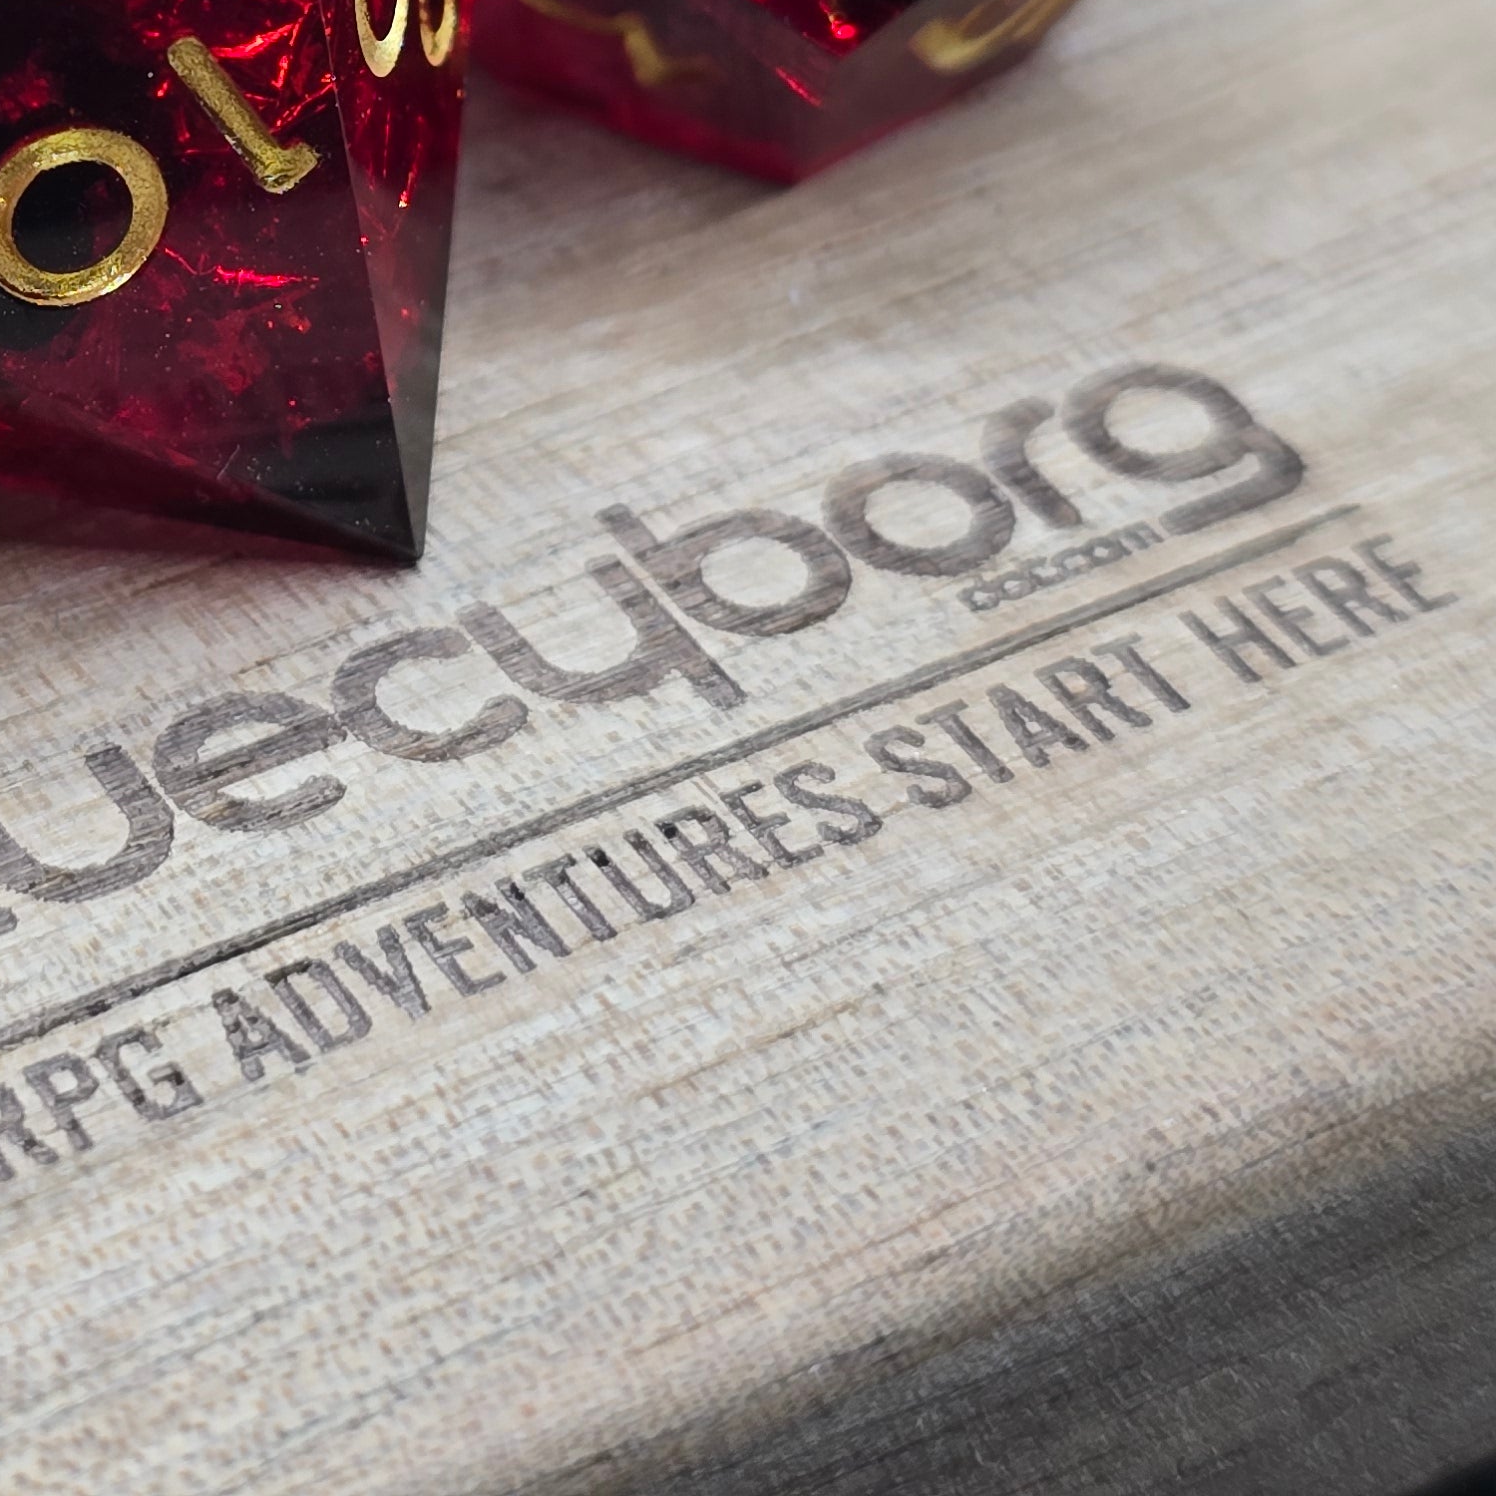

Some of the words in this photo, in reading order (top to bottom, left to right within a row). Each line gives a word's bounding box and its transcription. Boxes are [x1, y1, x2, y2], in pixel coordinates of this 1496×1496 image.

[211, 759, 882, 1083] ADVENTURES
[864, 632, 1191, 810] START
[1178, 532, 1459, 685] HERE
